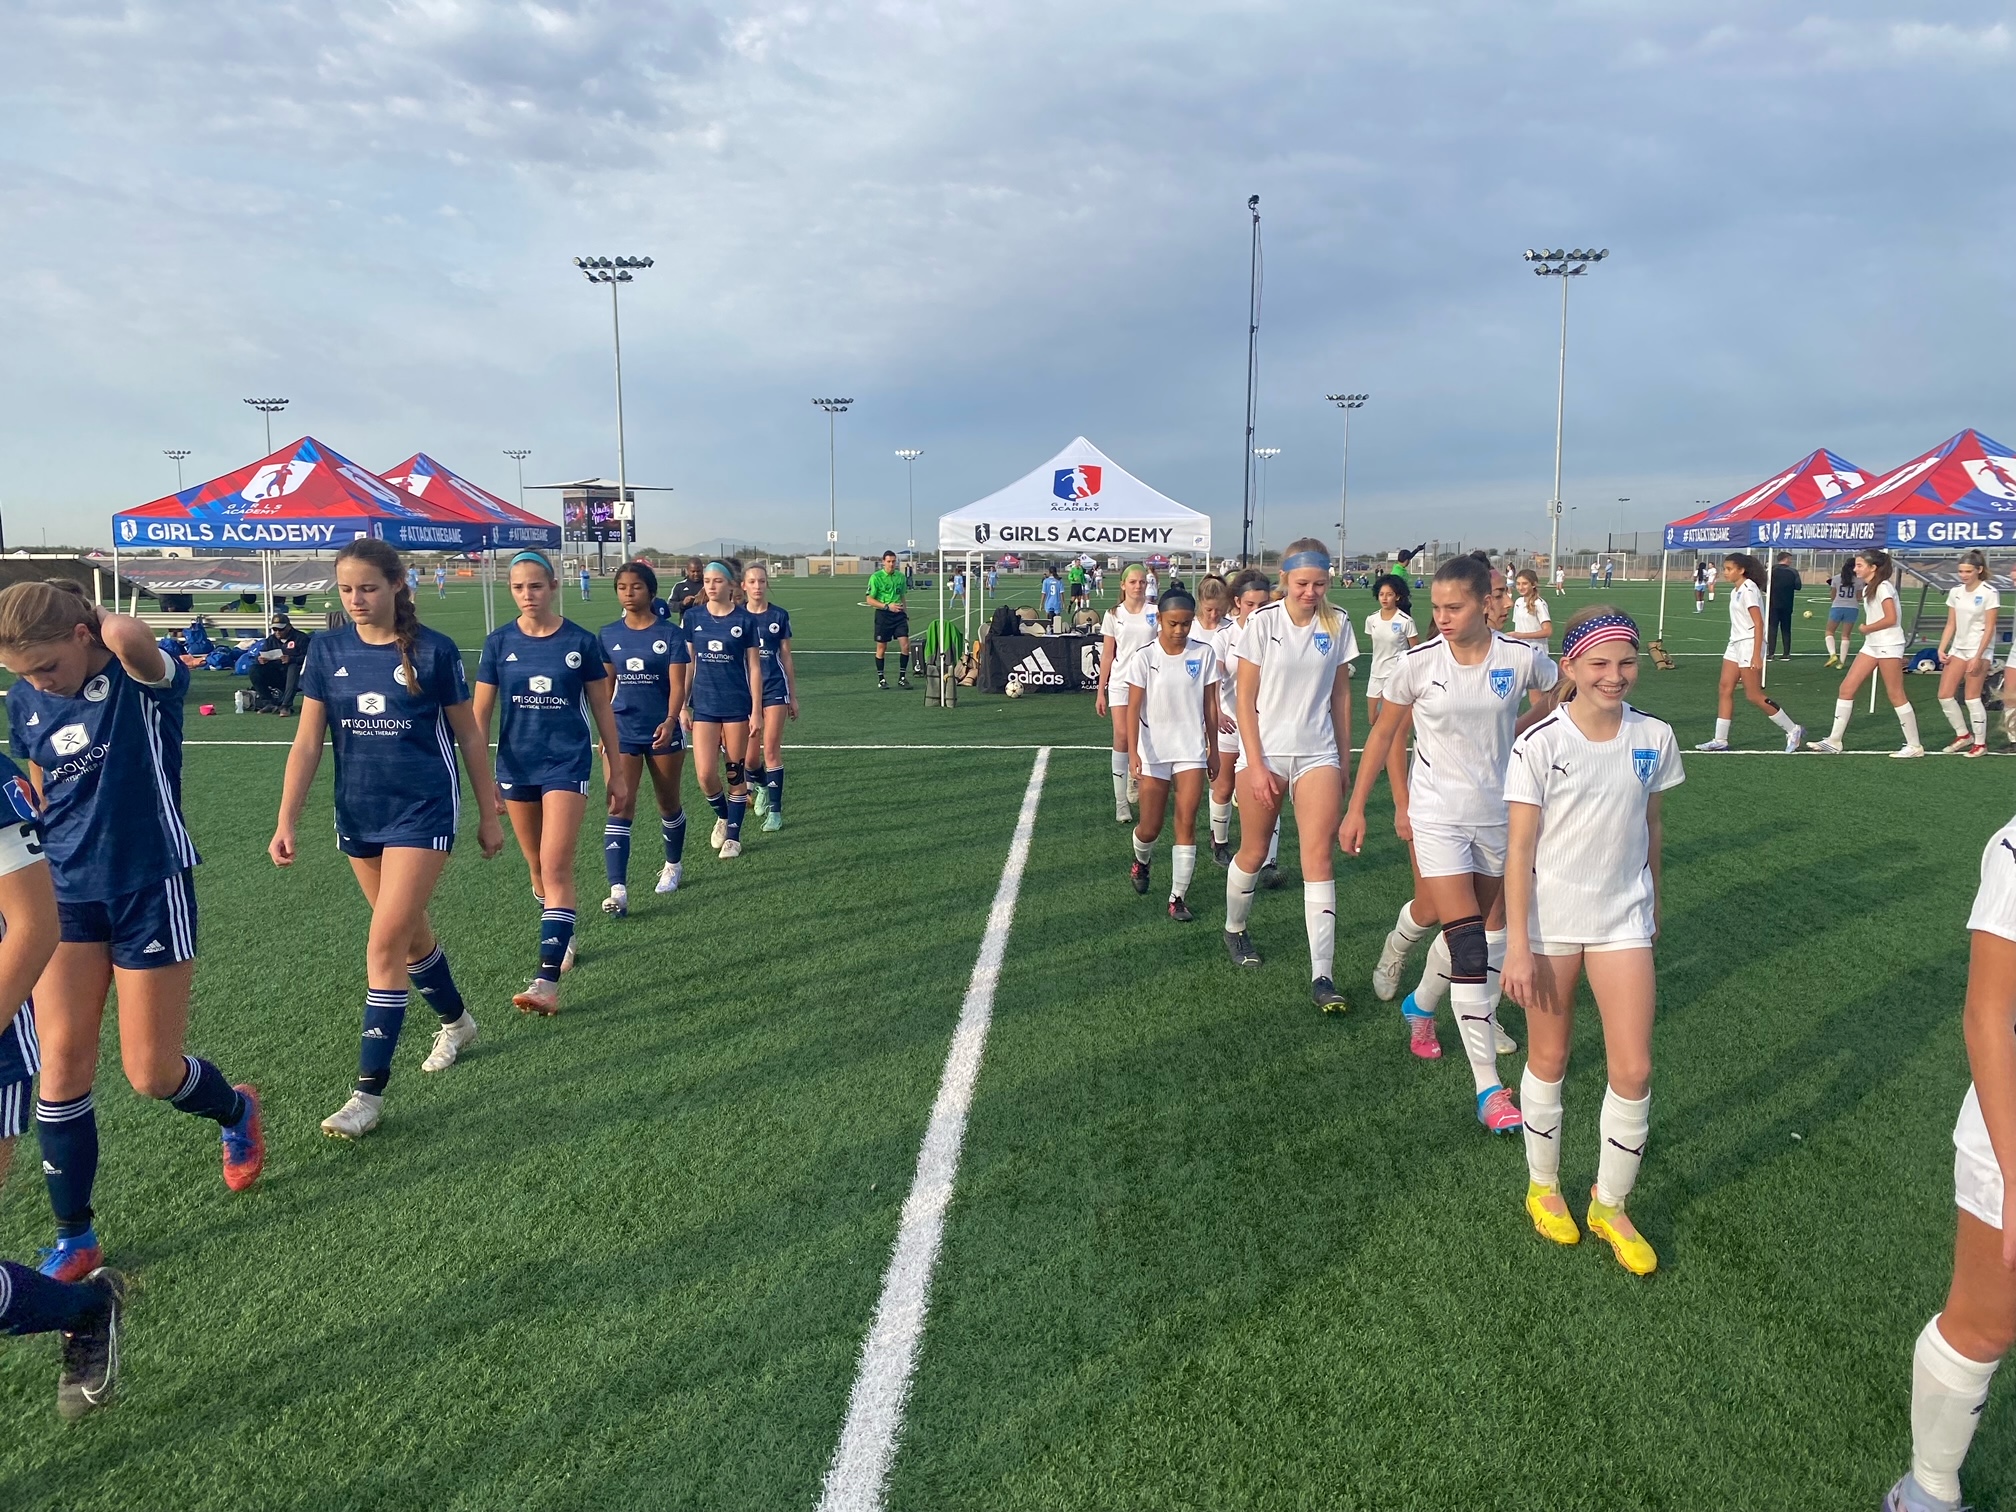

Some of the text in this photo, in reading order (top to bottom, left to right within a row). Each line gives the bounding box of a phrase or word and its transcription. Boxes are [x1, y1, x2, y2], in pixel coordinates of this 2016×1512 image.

[619, 503, 626, 515] 7
[1557, 501, 1562, 513] 6
[147, 523, 335, 542] GIRLS ACADEMY
[400, 525, 463, 543] #ATTACKTHEGAME
[508, 528, 549, 542] #ATTACKTHEGAME
[1000, 526, 1173, 543] GIRLS ACADEMY
[1683, 526, 1730, 543] #ATTACKTHEGAME
[1784, 522, 1875, 540] #THEVOICEOFTHEPLAYERS
[1927, 521, 2003, 540] GIRLS
[1050, 585, 1056, 595] 9
[623, 673, 659, 681] SOLUTIONS
[1008, 671, 1064, 685] adidas
[341, 719, 412, 729] PT SOLUTIONS
